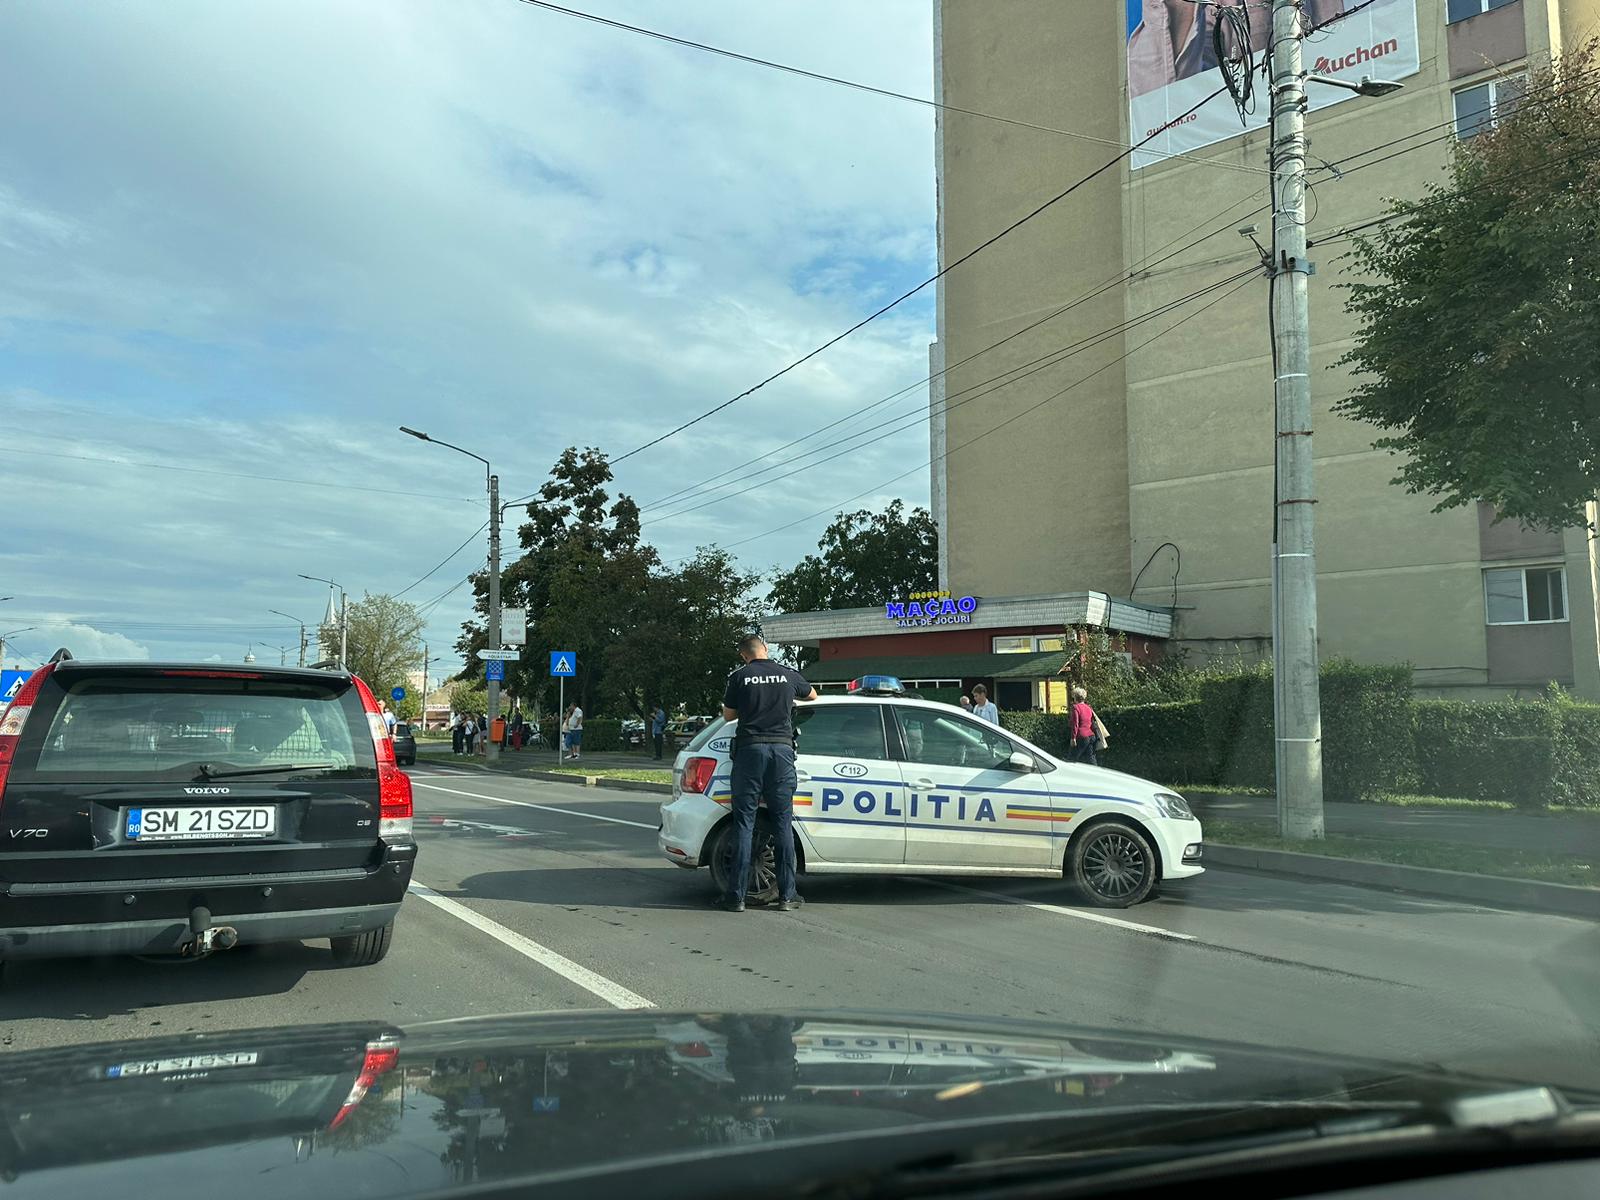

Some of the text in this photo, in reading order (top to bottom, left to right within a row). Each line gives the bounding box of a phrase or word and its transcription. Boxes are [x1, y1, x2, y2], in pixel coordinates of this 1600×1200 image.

[1314, 39, 1397, 74] Auchan
[1146, 113, 1197, 137] auchan.ro
[896, 615, 971, 628] SALA DE JOCURI
[744, 675, 788, 685] POLITIA
[848, 765, 861, 775] 112
[184, 787, 230, 795] VOLVO
[822, 788, 996, 823] POLITIA
[129, 809, 269, 832] RO SM 21 SZD
